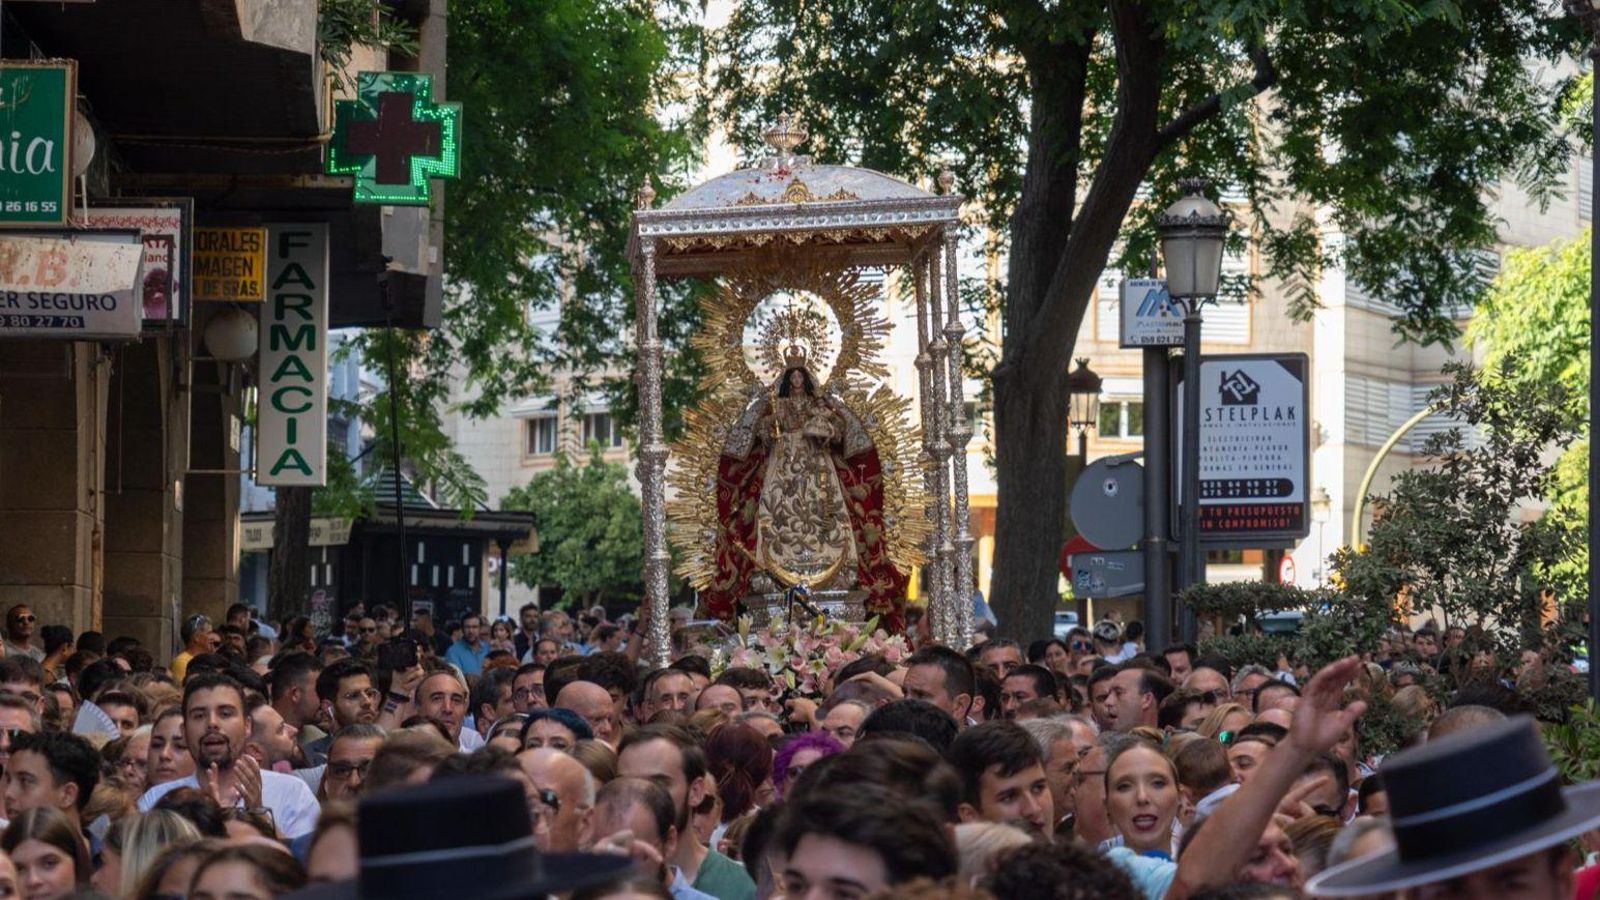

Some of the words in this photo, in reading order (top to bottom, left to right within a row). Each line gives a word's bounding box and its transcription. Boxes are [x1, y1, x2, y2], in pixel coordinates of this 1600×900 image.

[5, 201, 21, 212] 26
[25, 201, 38, 212] 16
[41, 201, 57, 212] 55
[27, 292, 117, 311] SEGURO
[11, 316, 30, 327] 80
[36, 316, 53, 327] 27
[62, 317, 80, 327] 70
[270, 231, 315, 476] FARMACIA
[1205, 406, 1295, 421] STELPLAK
[1203, 520, 1213, 528] IN
